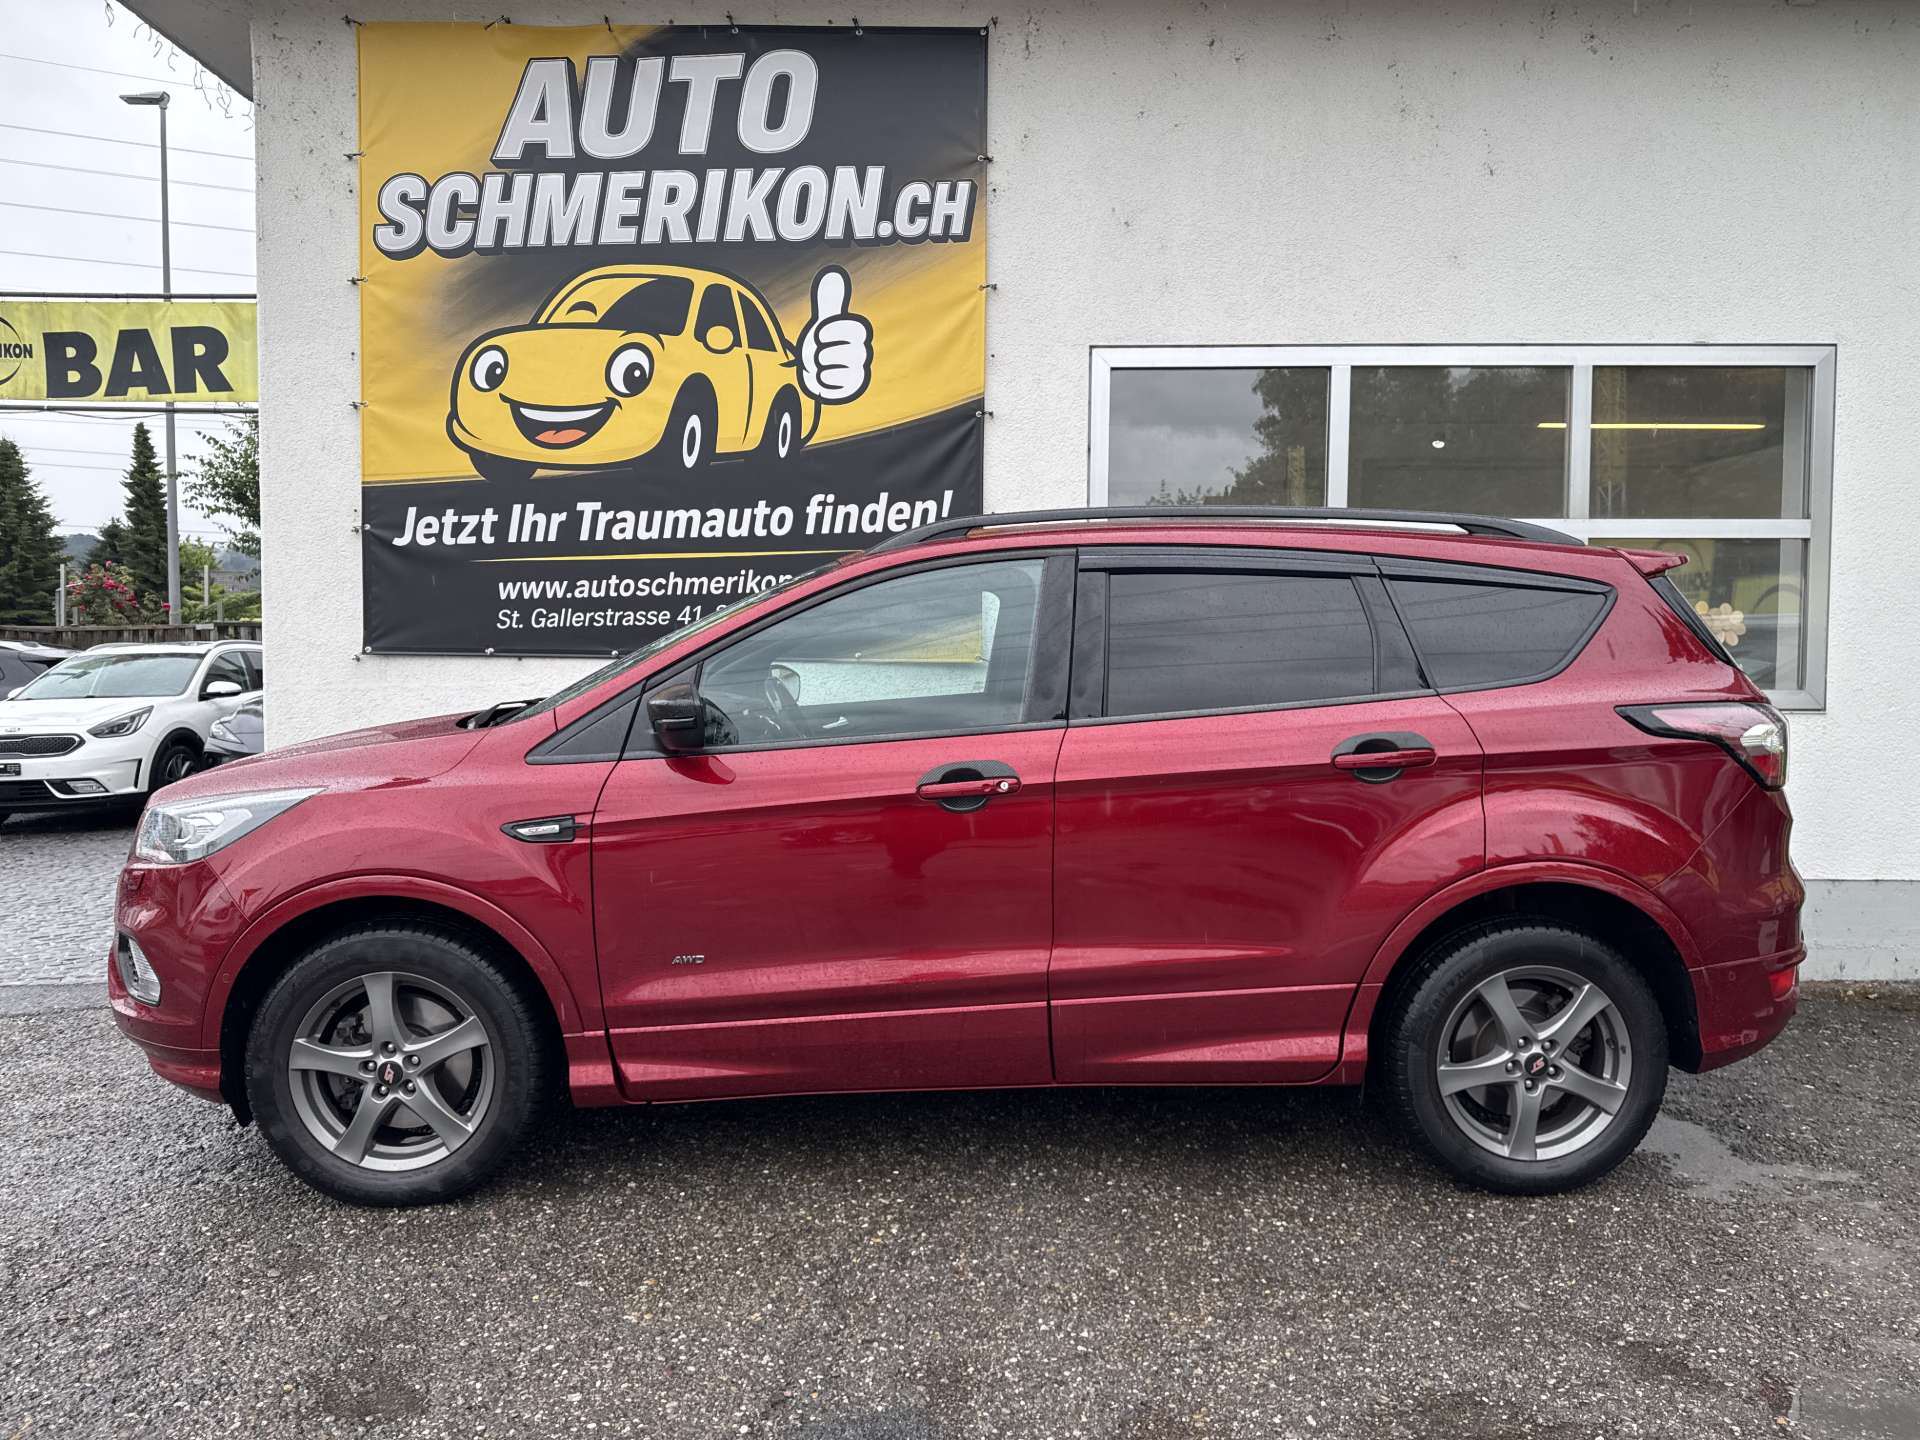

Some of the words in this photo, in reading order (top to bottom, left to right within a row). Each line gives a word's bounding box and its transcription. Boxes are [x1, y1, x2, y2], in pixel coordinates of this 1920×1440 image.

[491, 48, 819, 160] AUTO
[373, 165, 974, 251] SCHMERIKON.CH
[42, 325, 235, 399] BAR
[392, 506, 498, 546] Jetzt
[507, 503, 567, 543] Ihr
[576, 499, 794, 541] Traumauto
[805, 489, 954, 535] finden!
[496, 609, 524, 629] St.
[531, 607, 671, 629] Gallerstrasse
[677, 605, 702, 625] 41
